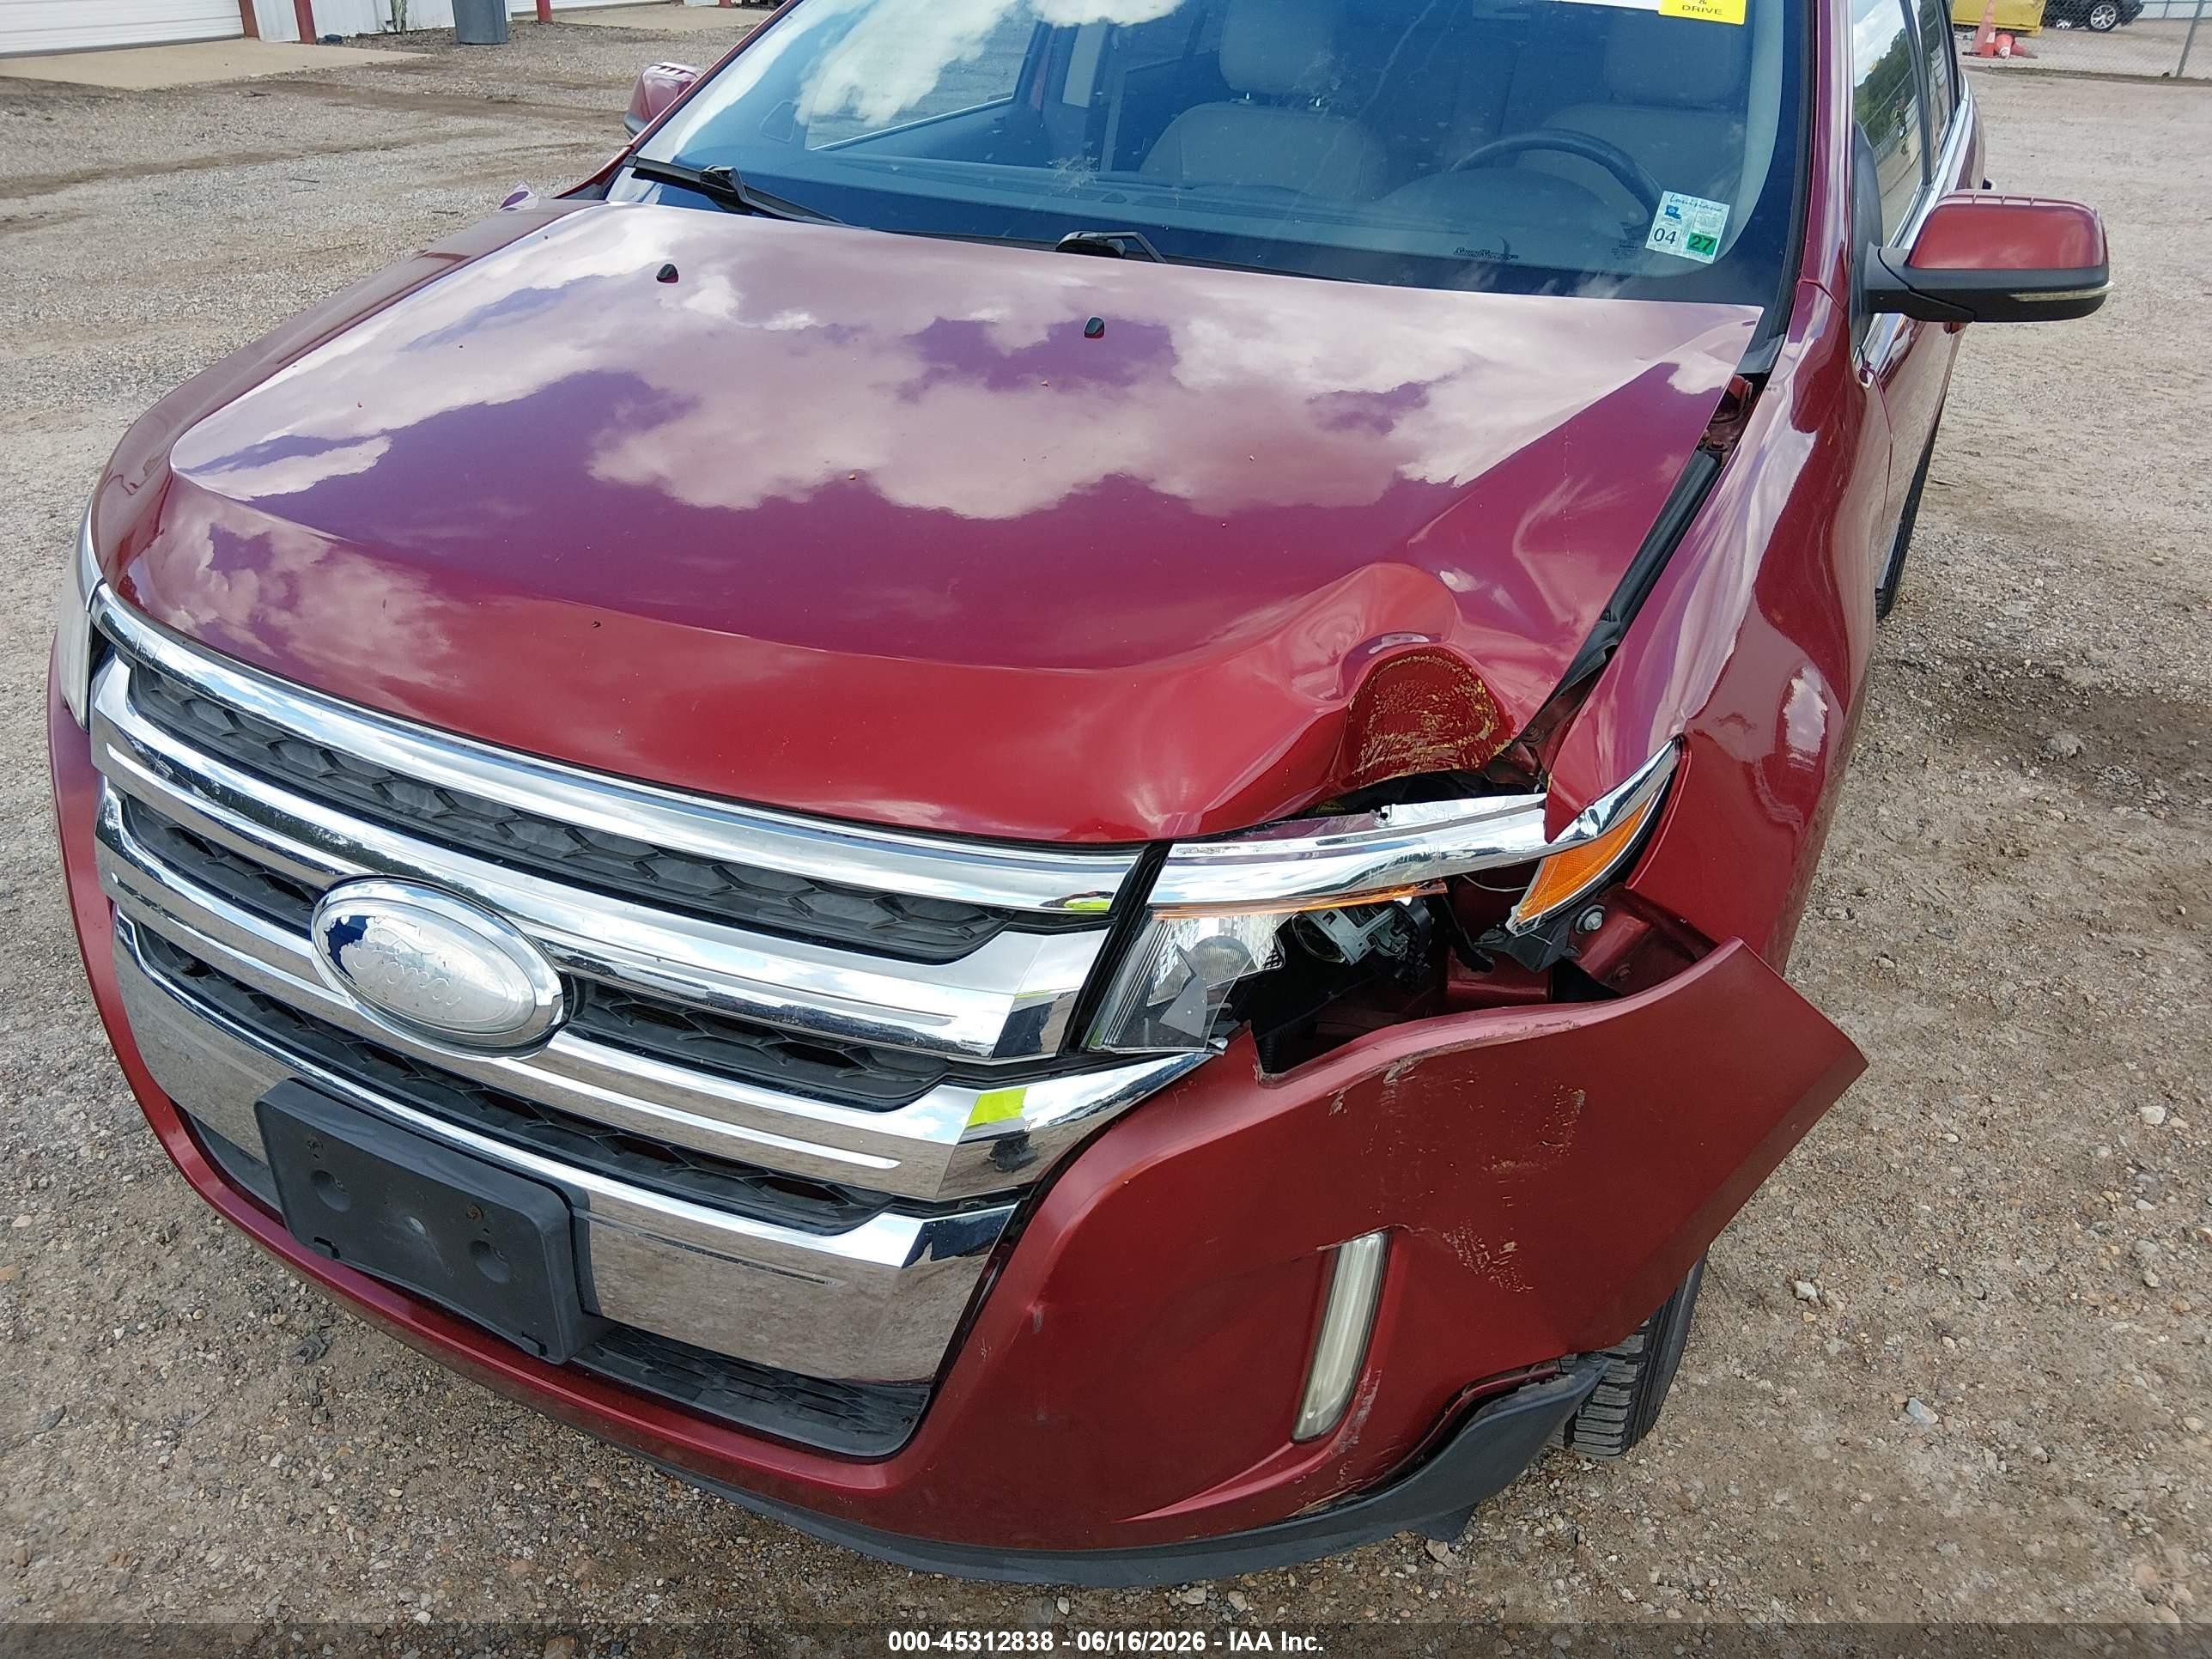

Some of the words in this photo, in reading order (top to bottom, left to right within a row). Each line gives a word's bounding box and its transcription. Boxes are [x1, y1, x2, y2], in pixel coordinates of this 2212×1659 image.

[1682, 5, 1723, 15] DRIVE
[1654, 228, 1677, 245] 04
[1690, 235, 1715, 254] 27
